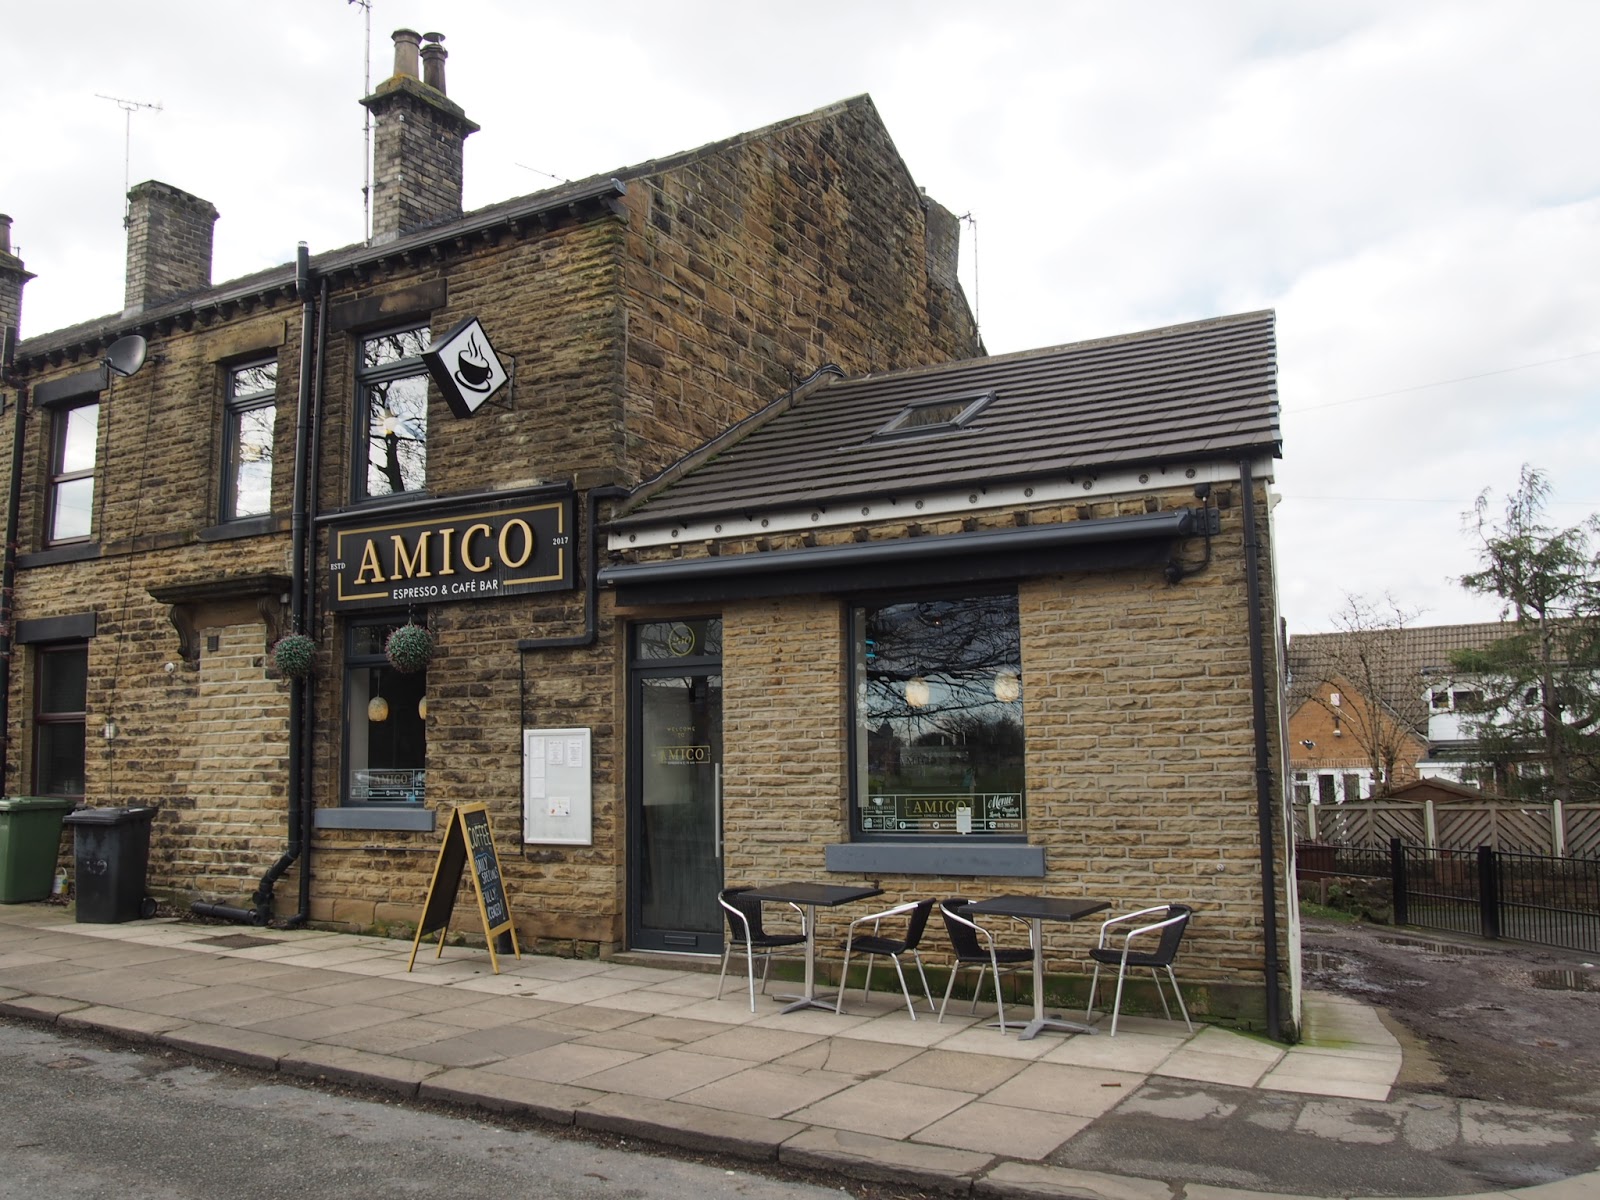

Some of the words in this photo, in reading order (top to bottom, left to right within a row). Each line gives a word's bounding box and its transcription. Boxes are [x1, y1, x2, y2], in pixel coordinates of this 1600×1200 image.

[552, 536, 569, 546] 2017
[354, 518, 533, 585] AMICO
[330, 562, 346, 571] ESTD
[393, 585, 438, 600] ESPRESSO
[441, 584, 448, 595] &
[451, 578, 477, 594] CAFÉ
[479, 579, 499, 592] BAR
[914, 800, 967, 814] AMICO
[468, 824, 492, 849] COFFEE
